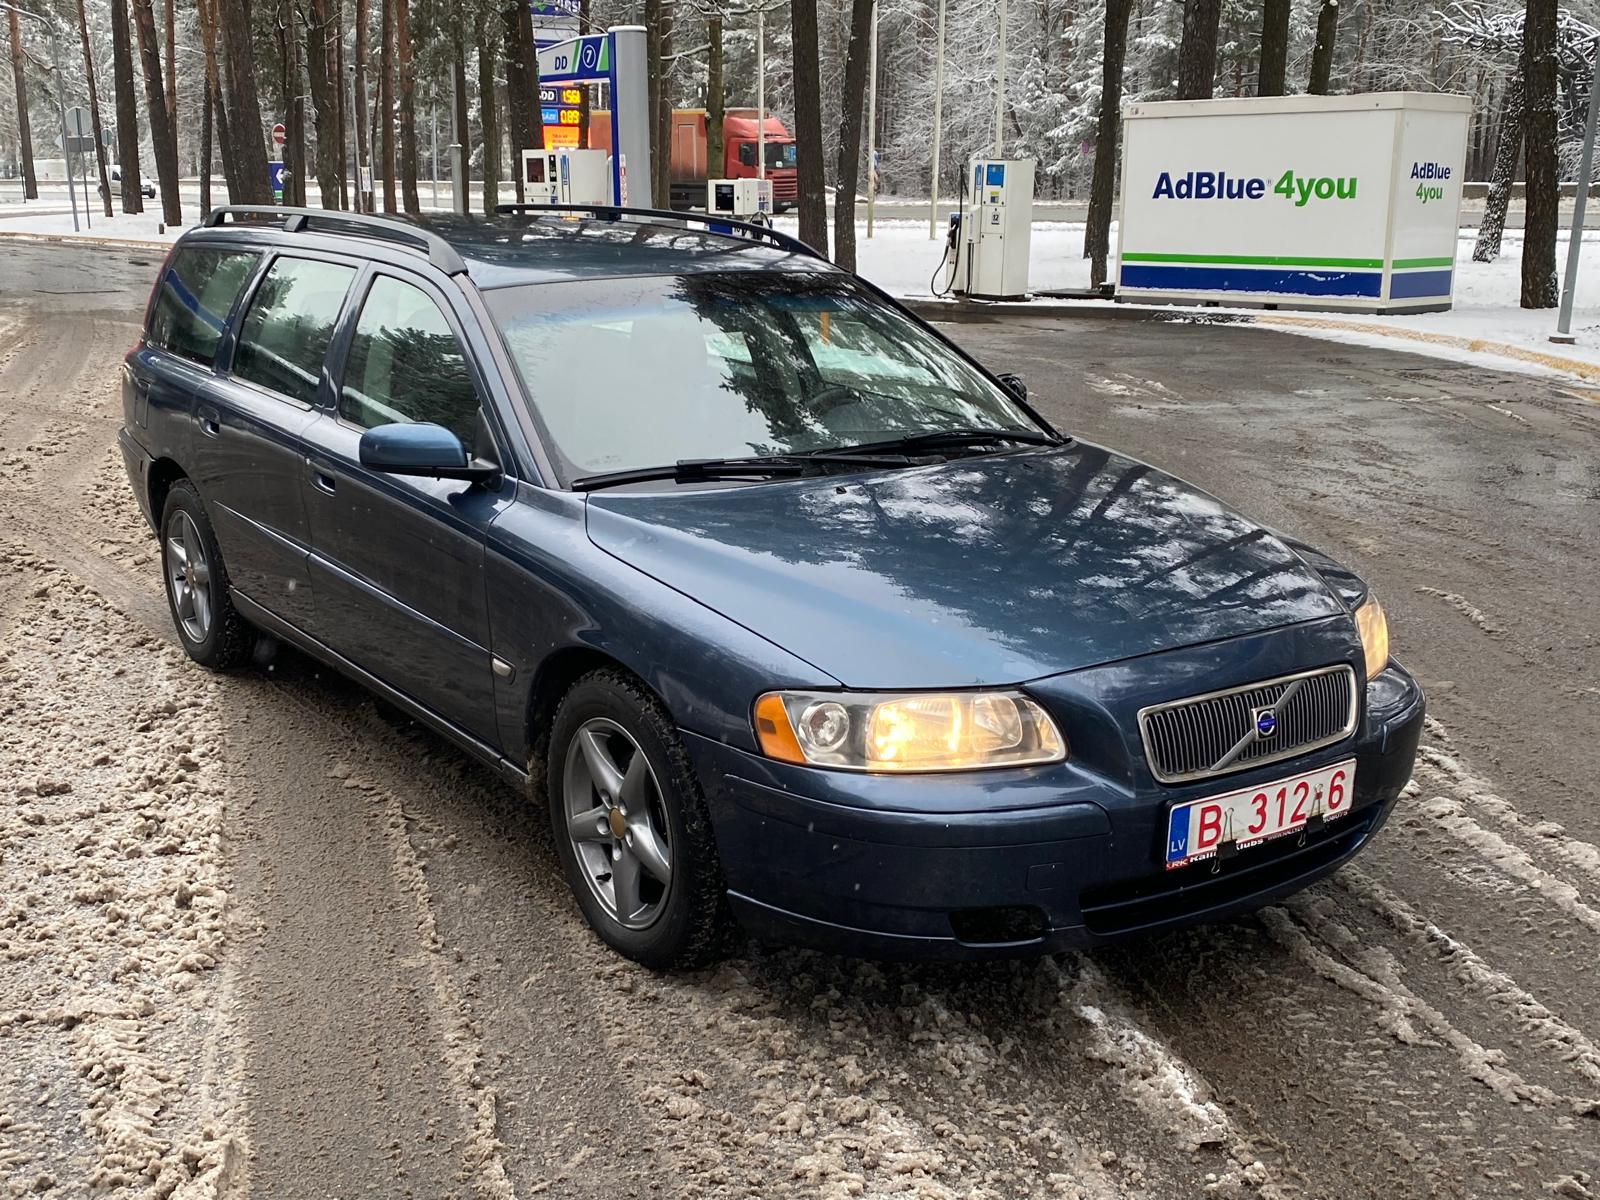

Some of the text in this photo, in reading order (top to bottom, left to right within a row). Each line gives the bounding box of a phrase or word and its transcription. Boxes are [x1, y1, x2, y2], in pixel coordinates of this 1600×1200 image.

[554, 49, 593, 71] DD 7
[1410, 161, 1451, 180] AdBlue
[1273, 170, 1358, 207] 4you
[1415, 182, 1443, 204] 4you
[1197, 804, 1222, 849] B
[1170, 838, 1187, 853] LV
